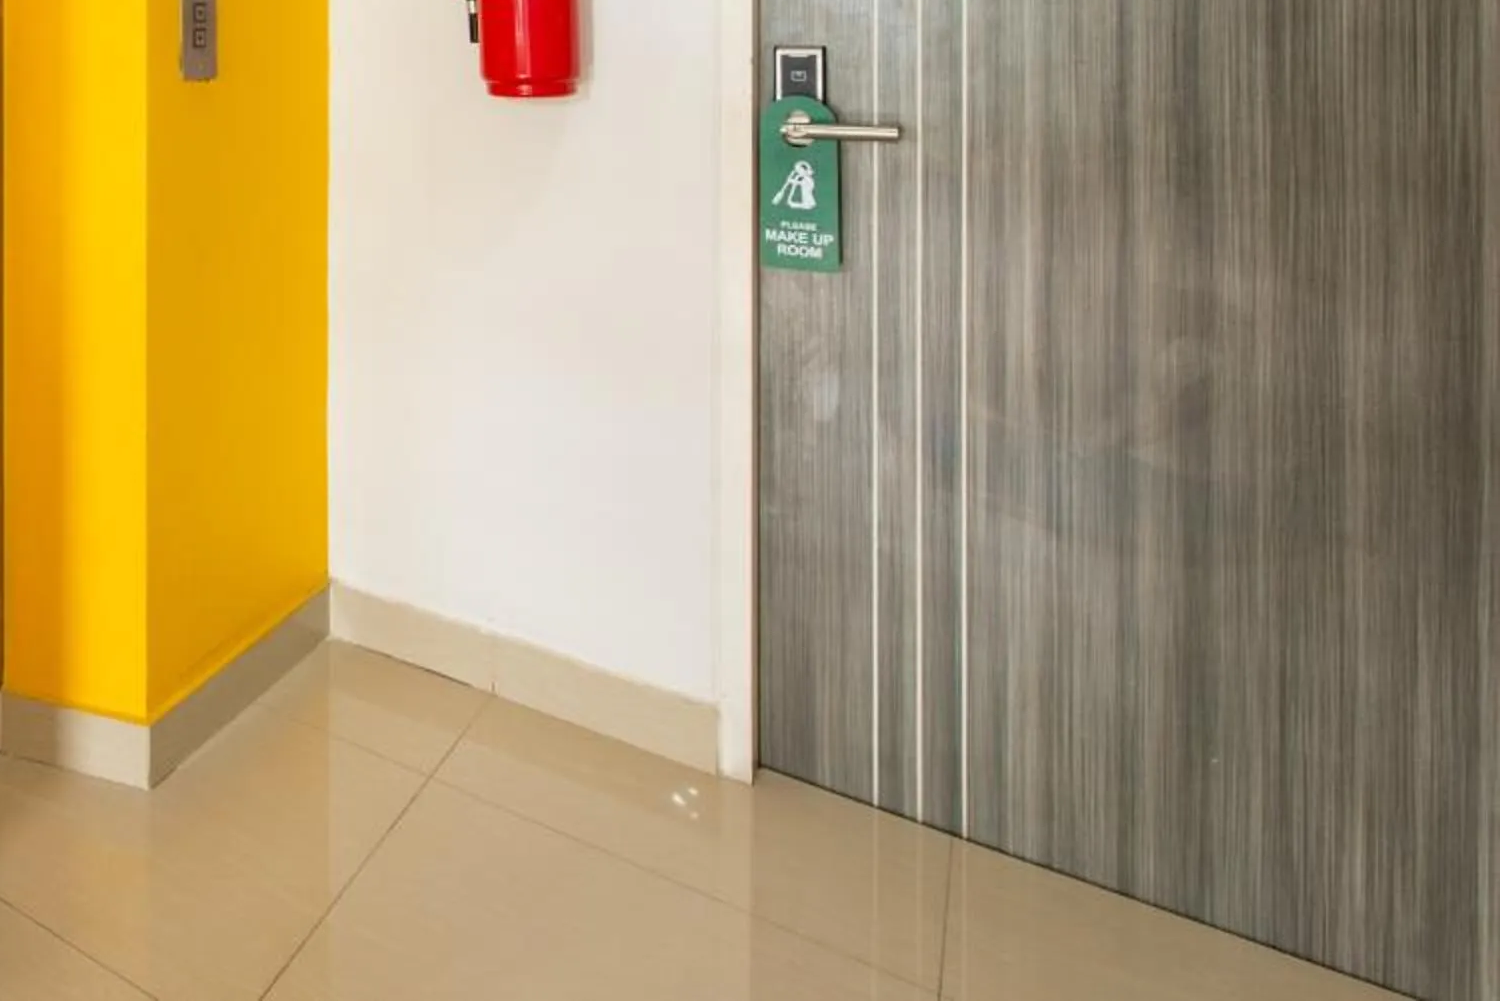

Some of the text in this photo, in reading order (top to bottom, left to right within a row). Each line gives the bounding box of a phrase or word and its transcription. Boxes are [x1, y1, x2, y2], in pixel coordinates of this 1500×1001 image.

[780, 220, 817, 232] PLEASE
[765, 228, 835, 247] MAKE UP
[777, 243, 823, 260] ROOM
